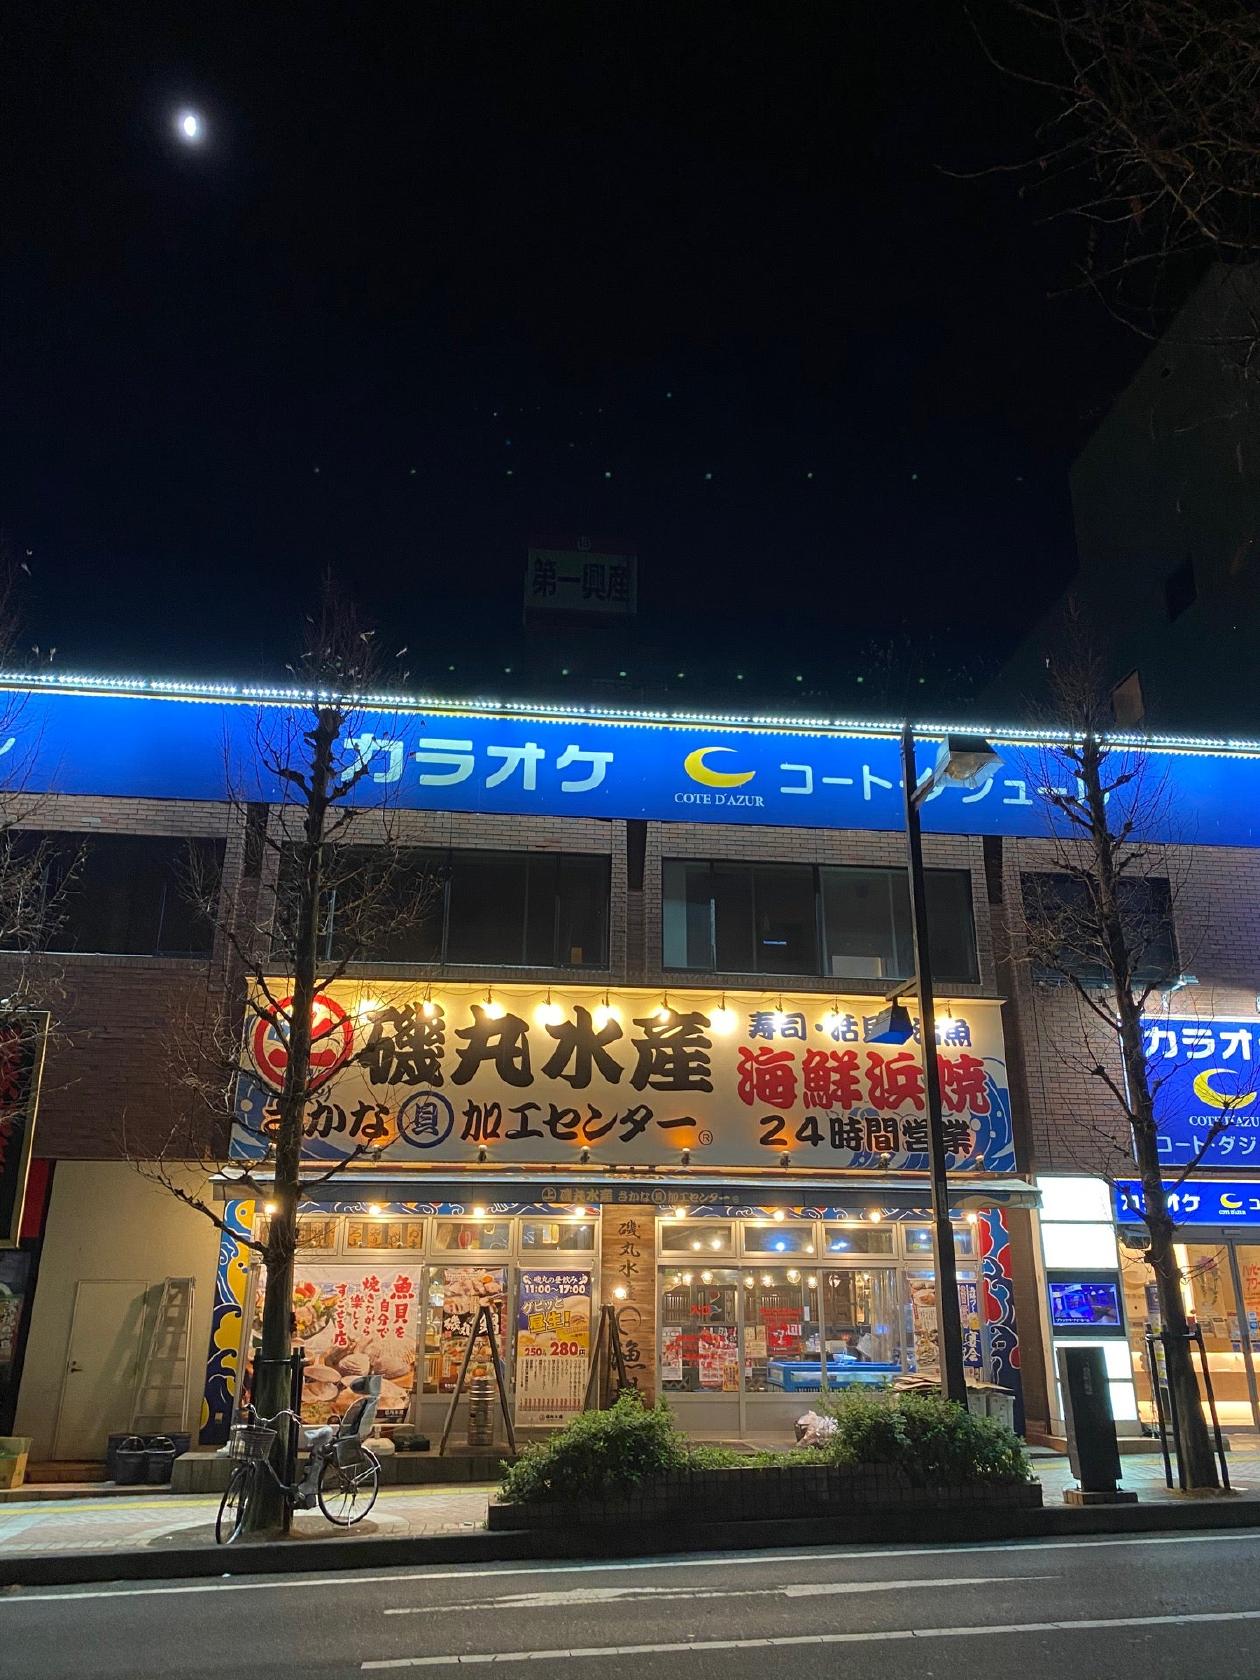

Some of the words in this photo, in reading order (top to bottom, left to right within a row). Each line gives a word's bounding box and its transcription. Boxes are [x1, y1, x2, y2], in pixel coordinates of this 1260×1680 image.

[341, 732, 614, 794] カラオケ
[674, 792, 711, 805] COTE
[366, 1001, 714, 1092] 磯丸水産
[1144, 1026, 1260, 1061] カラオ
[737, 1046, 990, 1114] 海鮮浜焼
[759, 1115, 973, 1155] 24時間営業
[333, 1283, 347, 1346] すごせる店
[350, 1294, 365, 1330] 楽しく
[362, 1275, 380, 1336] 焼きながら
[376, 1298, 389, 1338] 自分で
[390, 1275, 415, 1338] 魚貝を
